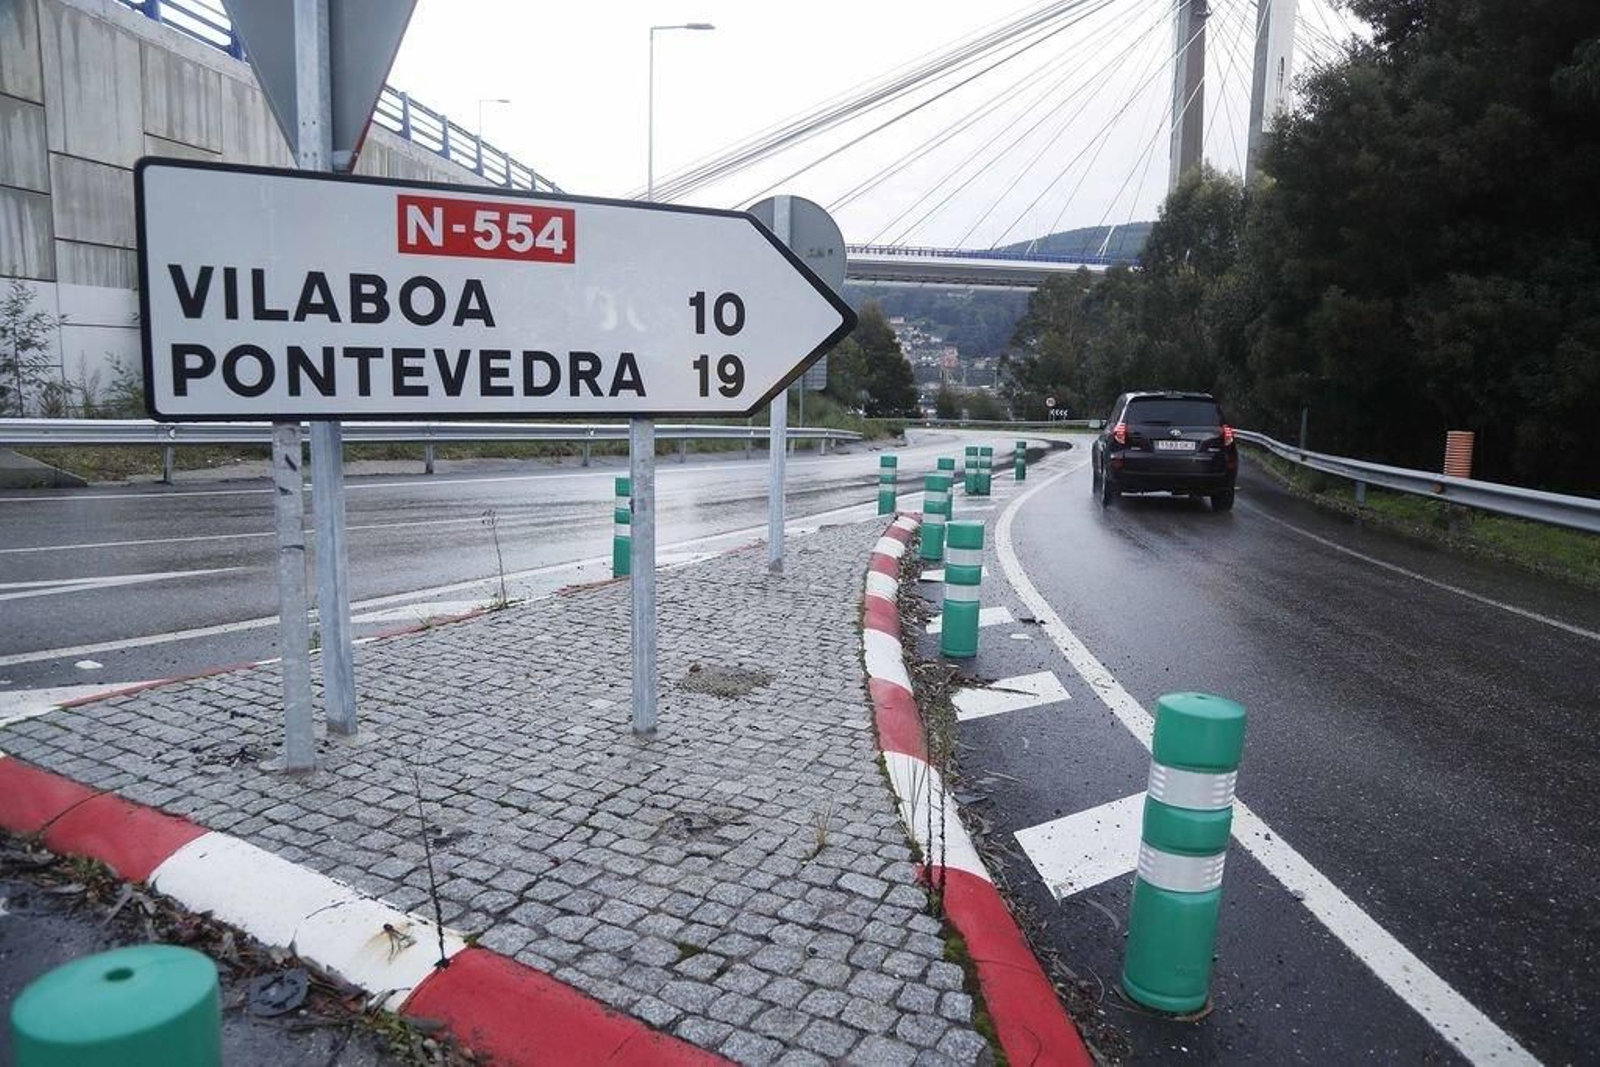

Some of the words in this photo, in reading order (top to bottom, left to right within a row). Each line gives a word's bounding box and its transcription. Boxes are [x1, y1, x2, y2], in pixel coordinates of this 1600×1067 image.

[406, 204, 568, 255] N-554
[168, 264, 496, 328] VILABOA
[689, 291, 746, 337] 10
[171, 343, 647, 398] PONTEVEDRA
[692, 354, 746, 399] 19
